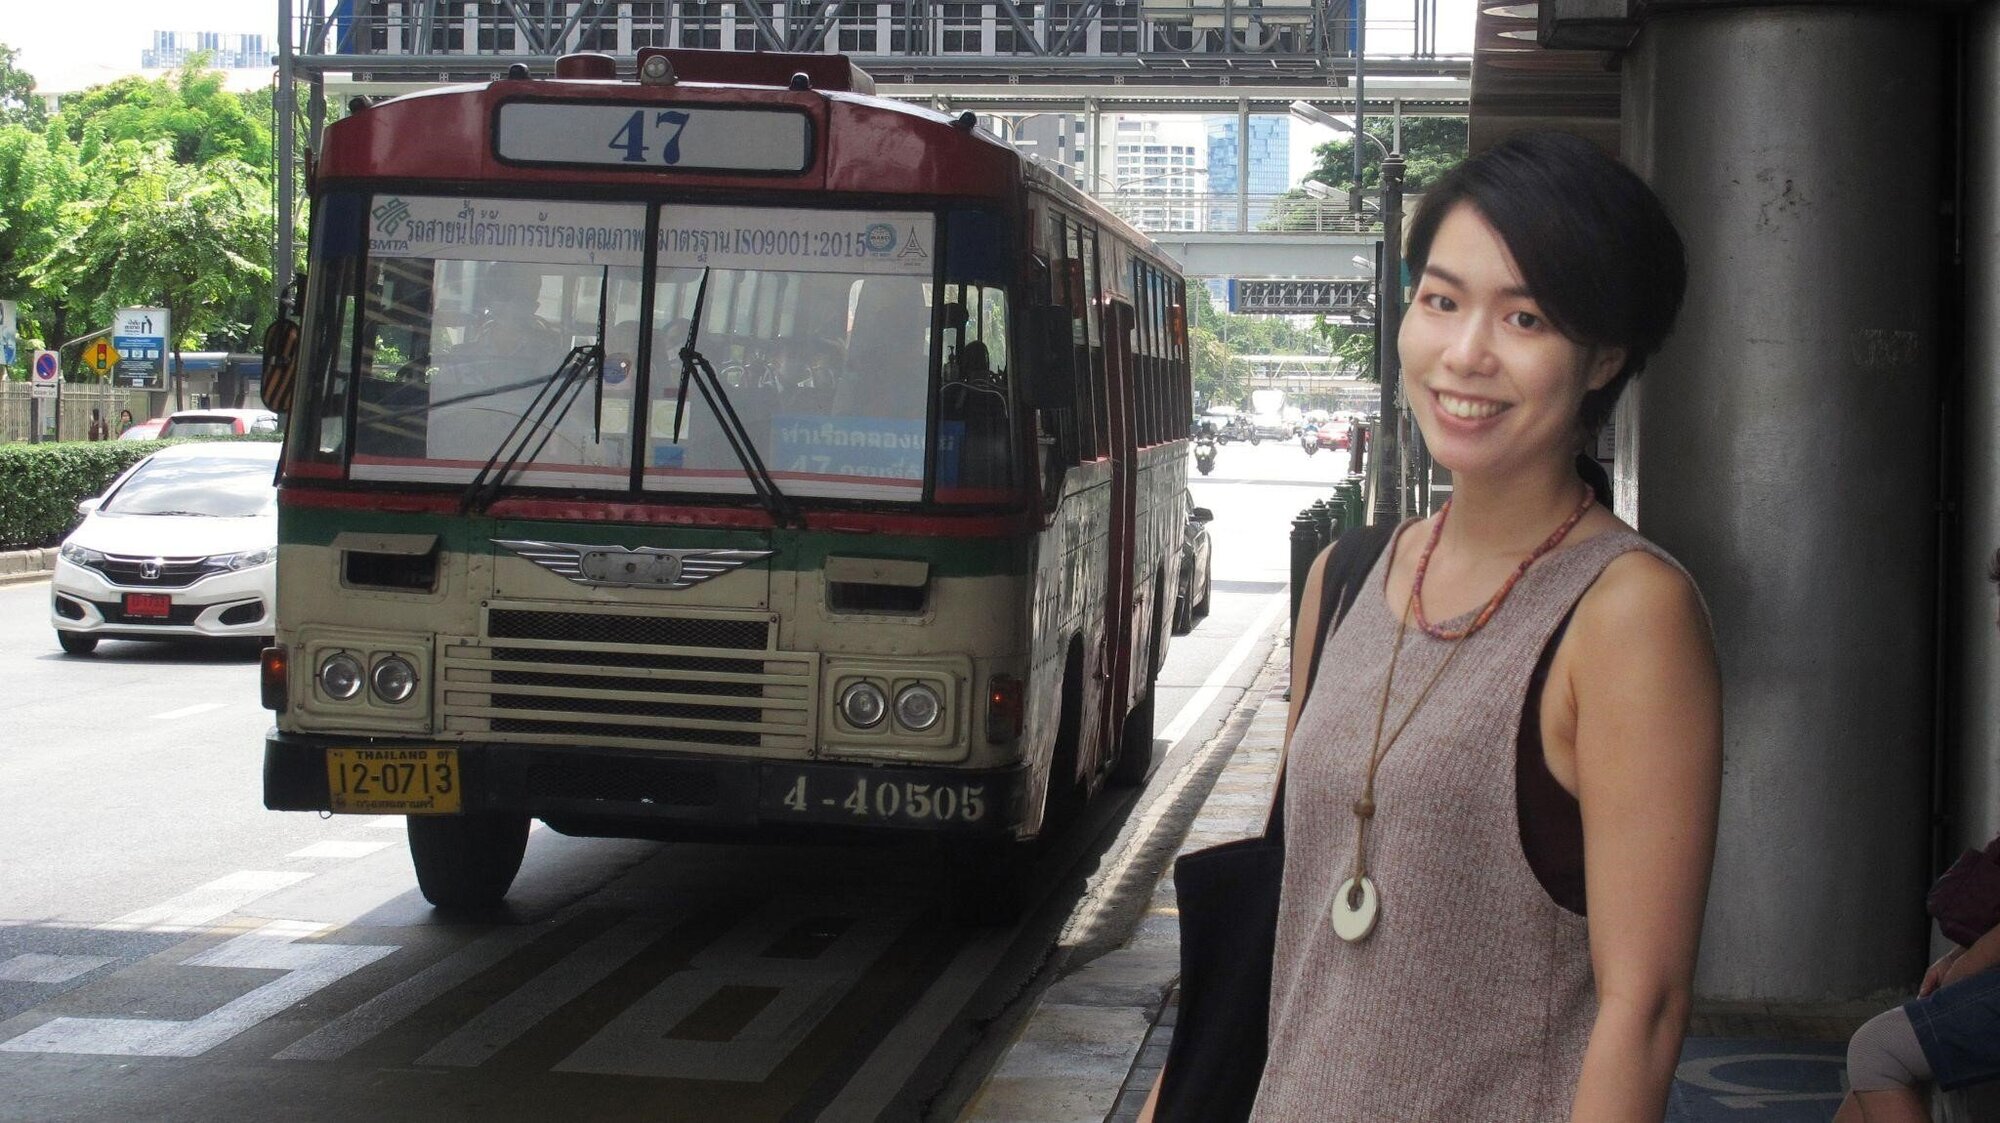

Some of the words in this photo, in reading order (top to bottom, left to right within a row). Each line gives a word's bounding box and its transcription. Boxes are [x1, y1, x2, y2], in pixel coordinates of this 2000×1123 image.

[608, 110, 691, 165] 47
[369, 239, 409, 250] BMTA
[733, 228, 867, 258] ISO9001:2015
[781, 422, 954, 450] ท่าเรือคลองเย
[355, 750, 428, 761] THAILAND
[339, 763, 453, 795] 12-0713
